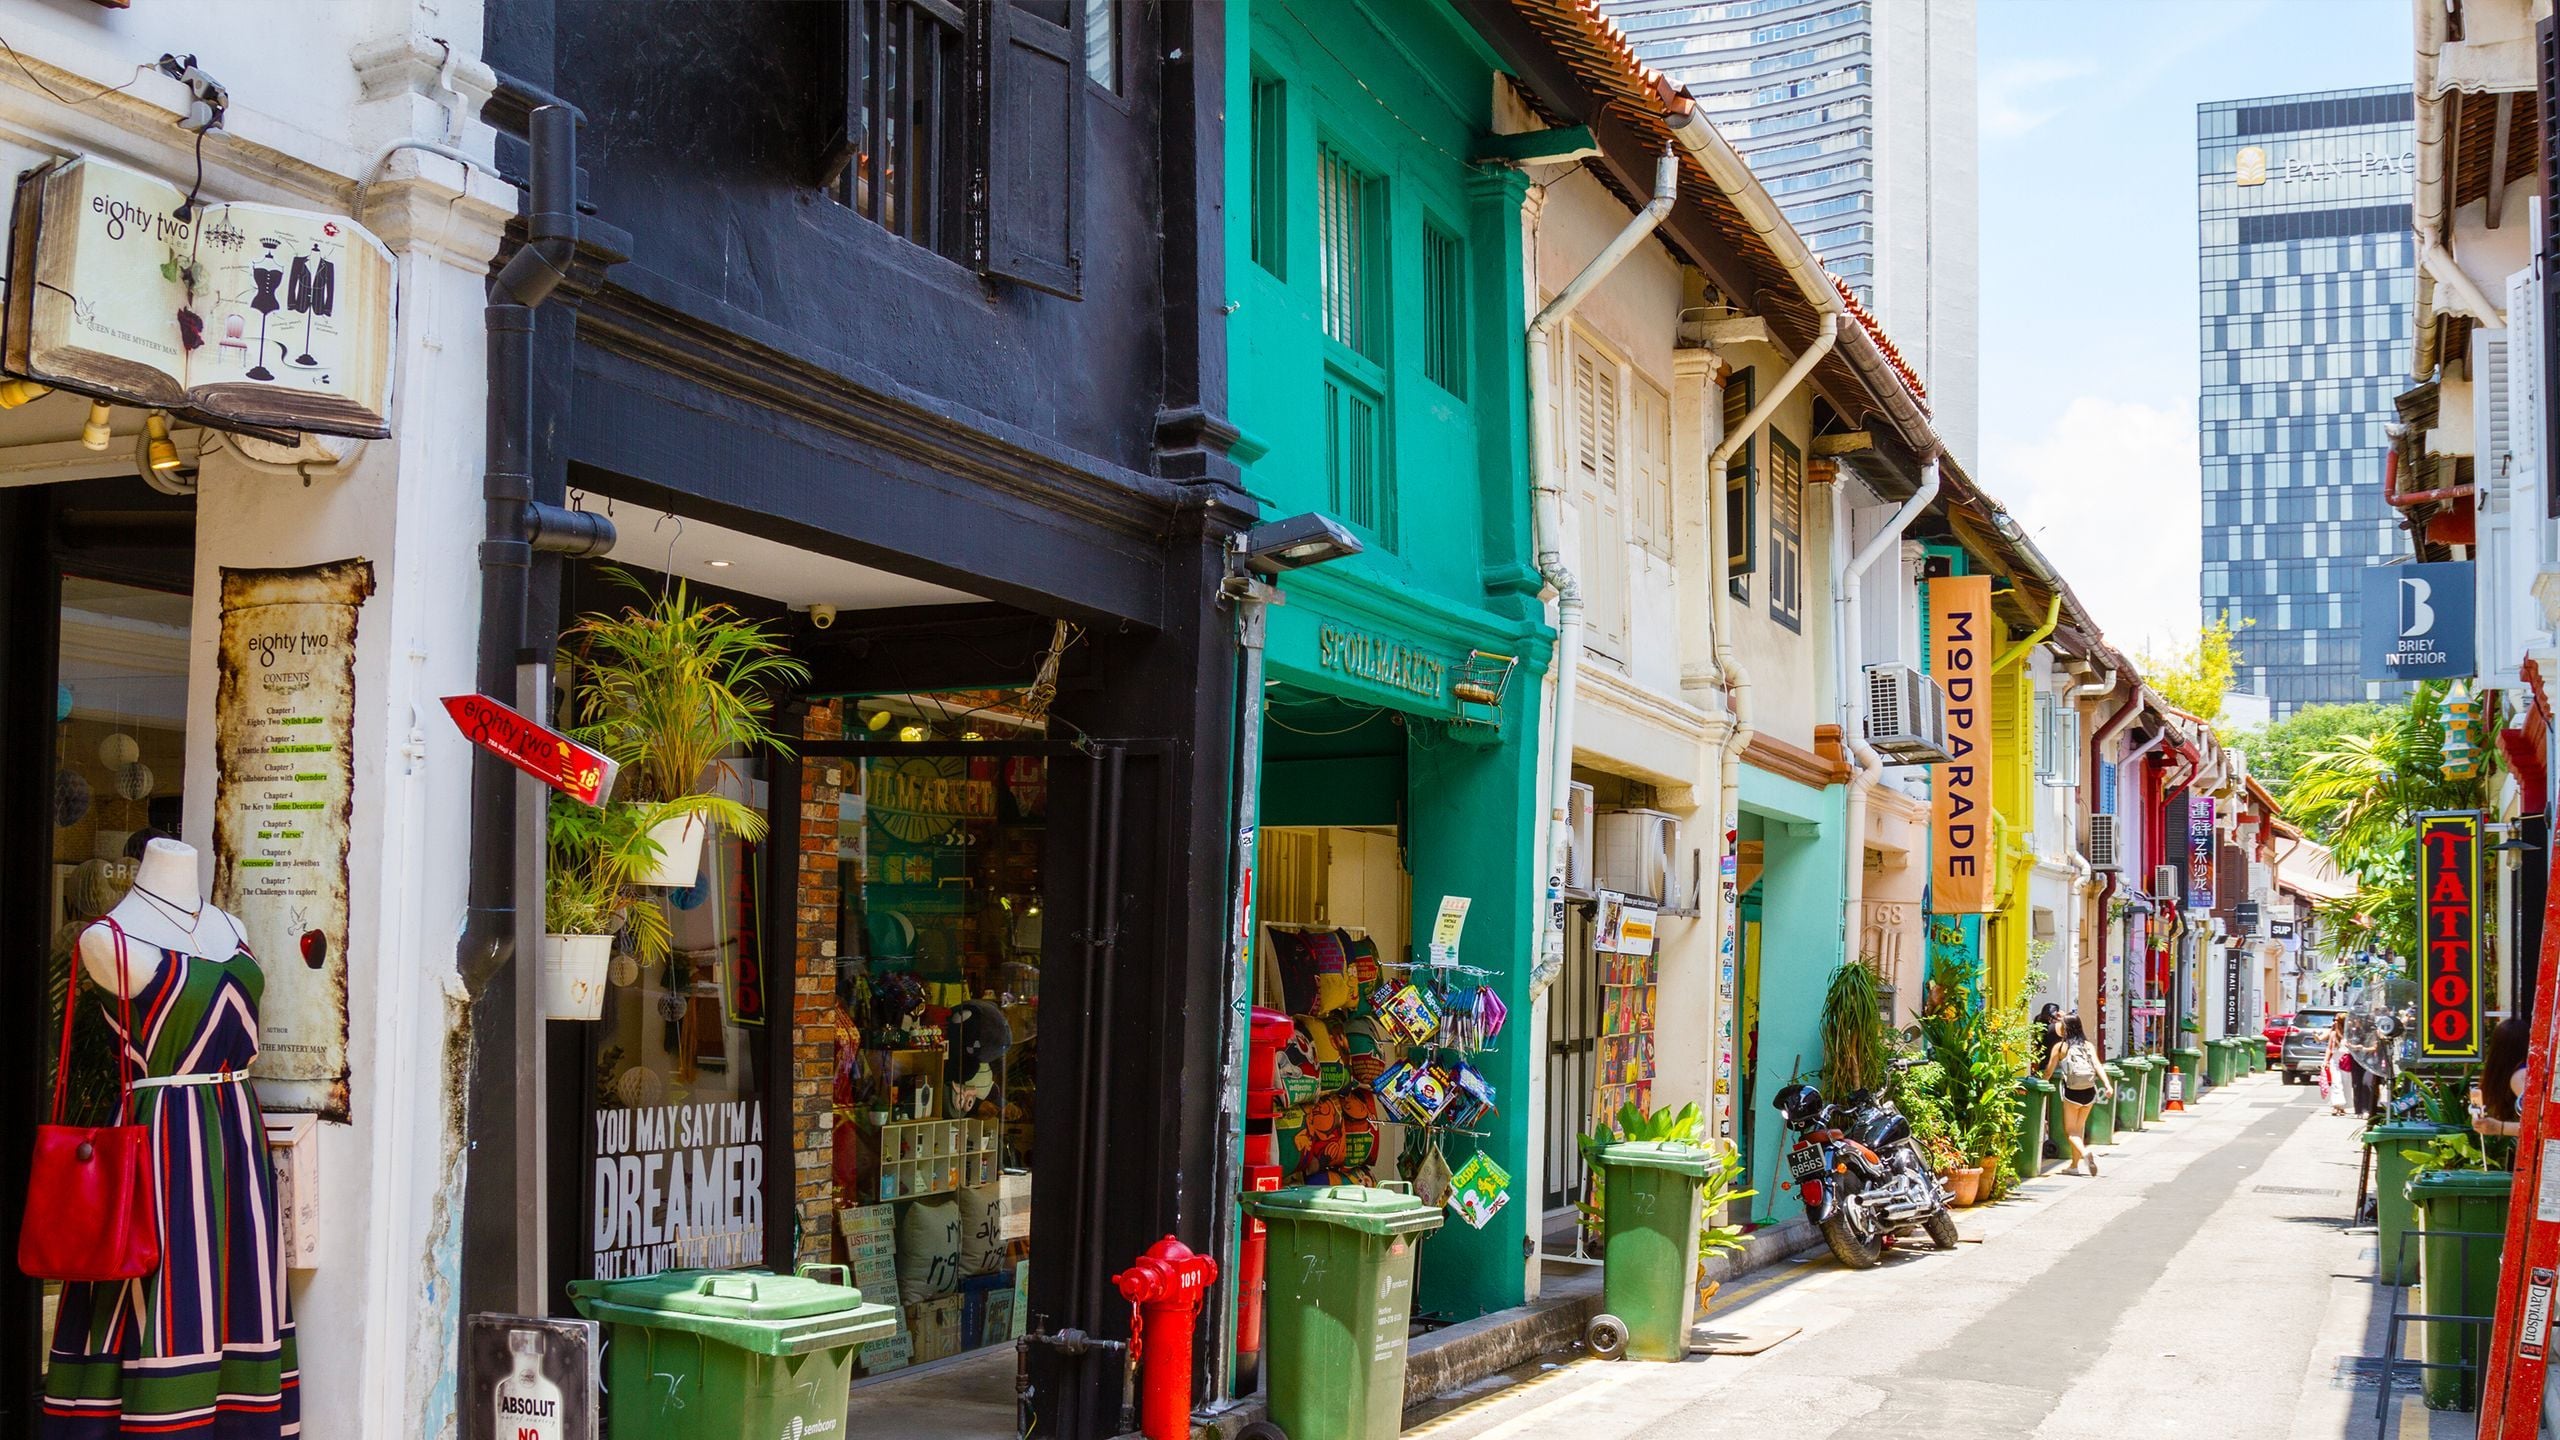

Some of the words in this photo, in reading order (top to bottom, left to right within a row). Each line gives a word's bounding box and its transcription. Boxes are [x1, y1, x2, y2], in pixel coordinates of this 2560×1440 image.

[2284, 158, 2343, 184] PAN
[93, 194, 152, 241] eighty
[157, 211, 189, 242] two
[117, 330, 131, 342] THE
[132, 335, 162, 351] MYSTERY
[162, 344, 178, 356] MAN
[248, 632, 297, 668] eighty
[300, 631, 329, 656] two
[2398, 639, 2435, 652] BRIEY
[2385, 651, 2447, 666] INTERIOR
[263, 672, 310, 684] CONTENTS
[266, 706, 291, 716] Chapter
[247, 718, 266, 727] Eighty
[268, 718, 281, 726] Two
[281, 717, 302, 726] Stylish
[464, 700, 518, 744] eighty
[518, 728, 552, 759] two
[261, 745, 270, 754] for
[271, 746, 290, 754] Man's
[291, 745, 315, 753] Fashion
[316, 744, 333, 753] Wear
[1947, 611, 1976, 878] MODPARADE
[264, 763, 289, 772] Chapter
[280, 773, 293, 781] with
[263, 792, 288, 800] Chapter
[252, 803, 264, 811] Key
[273, 802, 291, 810] Home
[292, 801, 325, 810] Decoration
[262, 820, 287, 828] Chapter
[258, 832, 272, 840] Bags
[262, 849, 287, 857] Chapter
[241, 860, 274, 868] Accessories
[282, 861, 291, 869] my
[261, 877, 286, 885] Chapter
[242, 888, 254, 896] The
[254, 888, 287, 896] Challenges
[1876, 903, 1903, 924] 68
[1939, 927, 1965, 945] 66
[2272, 925, 2292, 935] SUP
[2423, 831, 2476, 1042] TATTOO
[2229, 972, 2237, 991] NAIL
[2228, 995, 2237, 1026] SOCIAL
[261, 1043, 275, 1052] THE
[278, 1044, 309, 1053] MYSTERY
[596, 1108, 631, 1155] YOU
[636, 1105, 679, 1153] MAY
[680, 1103, 716, 1148] SAY
[720, 1101, 746, 1145] I'M
[751, 1100, 763, 1142] A
[1797, 1150, 1811, 1163] FR
[1453, 1158, 1480, 1188] Casper
[594, 1144, 763, 1252] DREAMER
[873, 1206, 892, 1217] more
[880, 1217, 894, 1226] less
[850, 1232, 873, 1247] LISTEN
[874, 1233, 890, 1243] more
[594, 1250, 623, 1281] BUT
[626, 1246, 649, 1278] I'M
[651, 1242, 678, 1275] NOT
[681, 1237, 706, 1270] THE
[708, 1233, 737, 1268] ONLY
[741, 1230, 763, 1264] ONE
[875, 1247, 887, 1255] less
[875, 1260, 892, 1270] more
[881, 1270, 895, 1279] less
[1181, 1269, 1202, 1289] 1091
[881, 1285, 896, 1295] more
[883, 1296, 898, 1305] less
[2528, 1286, 2548, 1342] Davidson
[864, 1338, 890, 1353] BELIEVE
[891, 1336, 907, 1346] more
[892, 1350, 905, 1359] less
[654, 1373, 685, 1417] 76
[501, 1396, 556, 1418] ABSOLUT
[518, 1427, 540, 1440] NO
[803, 1418, 837, 1437] sembcorp
